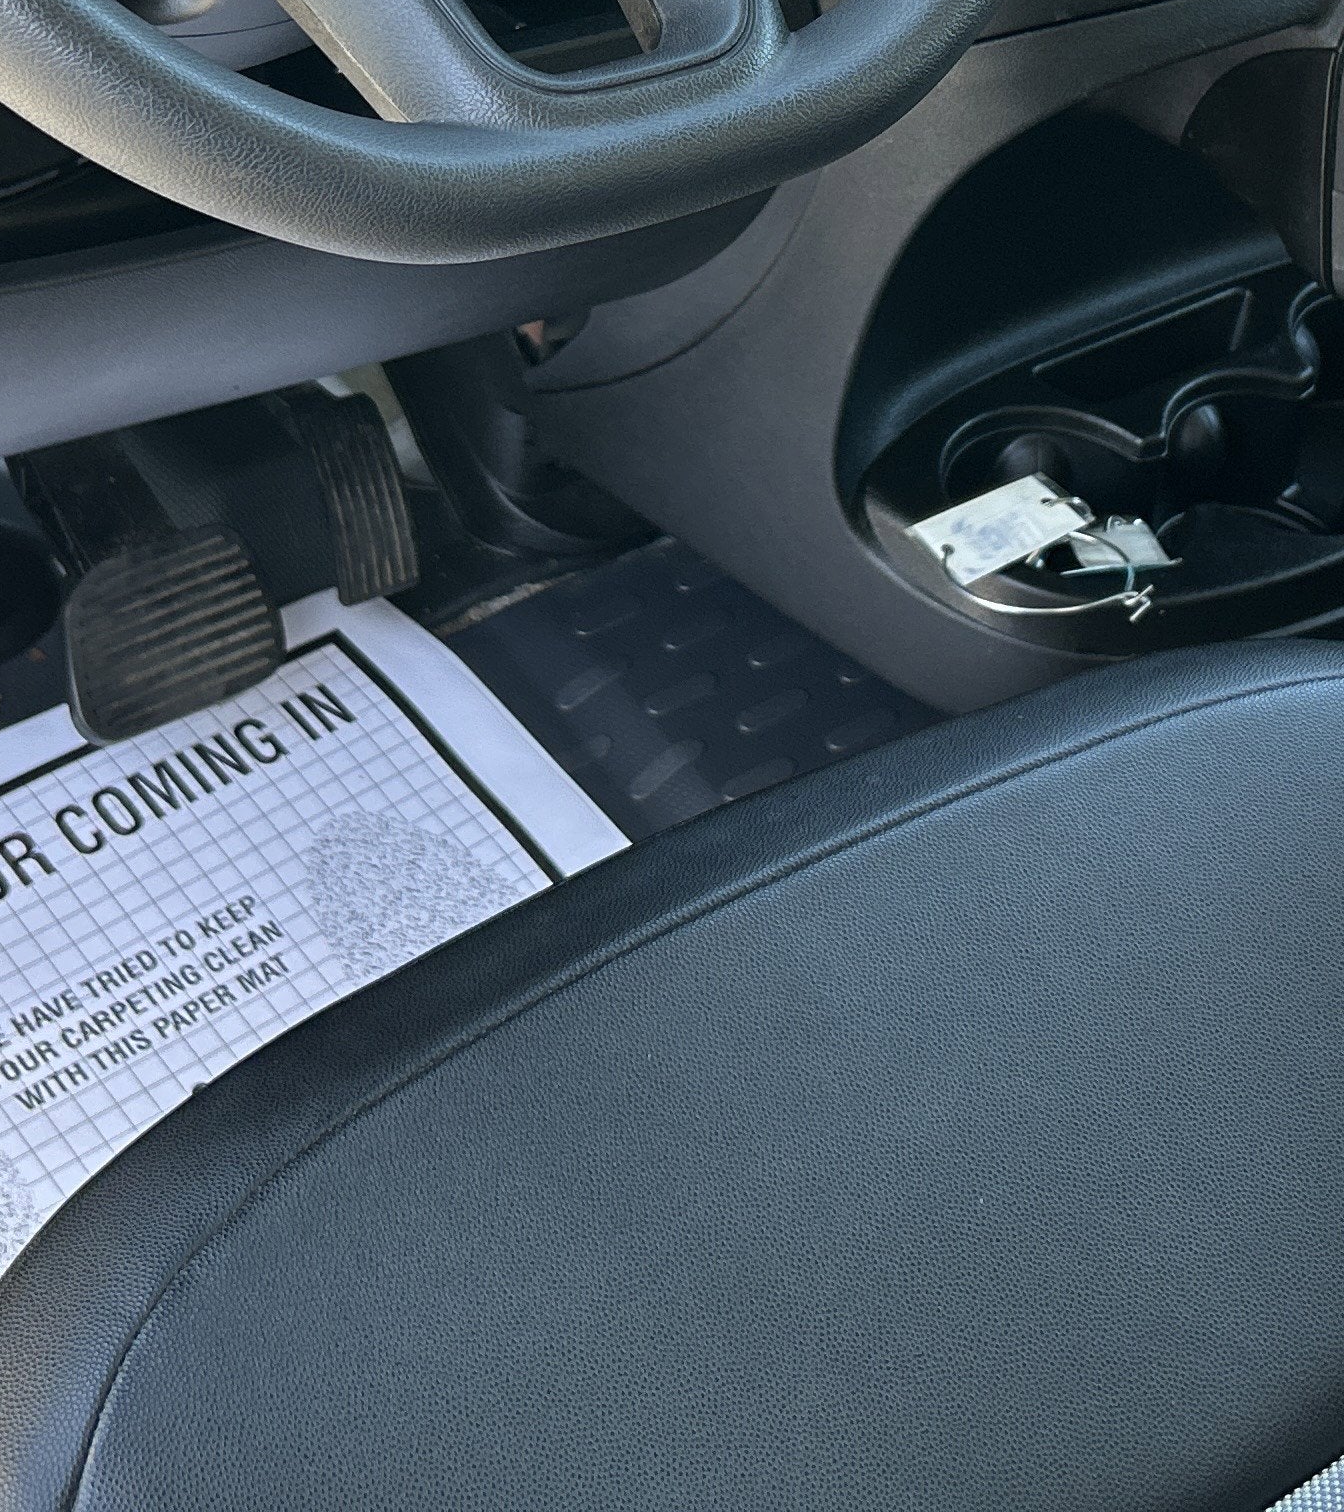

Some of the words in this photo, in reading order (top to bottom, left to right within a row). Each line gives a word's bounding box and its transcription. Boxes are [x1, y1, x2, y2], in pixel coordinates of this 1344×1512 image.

[55, 718, 288, 856] COMING
[278, 682, 360, 743] IN
[10, 989, 84, 1037] HAVE
[80, 949, 158, 1001] TRIED
[157, 929, 197, 960] TO
[196, 893, 259, 939] KEEP
[14, 1062, 89, 1112] WITH
[87, 1028, 154, 1072] THIS
[151, 983, 239, 1040] PAPER
[235, 953, 291, 995] MAT
[61, 963, 204, 1050] CARPETING
[205, 920, 285, 975] CLEAN
